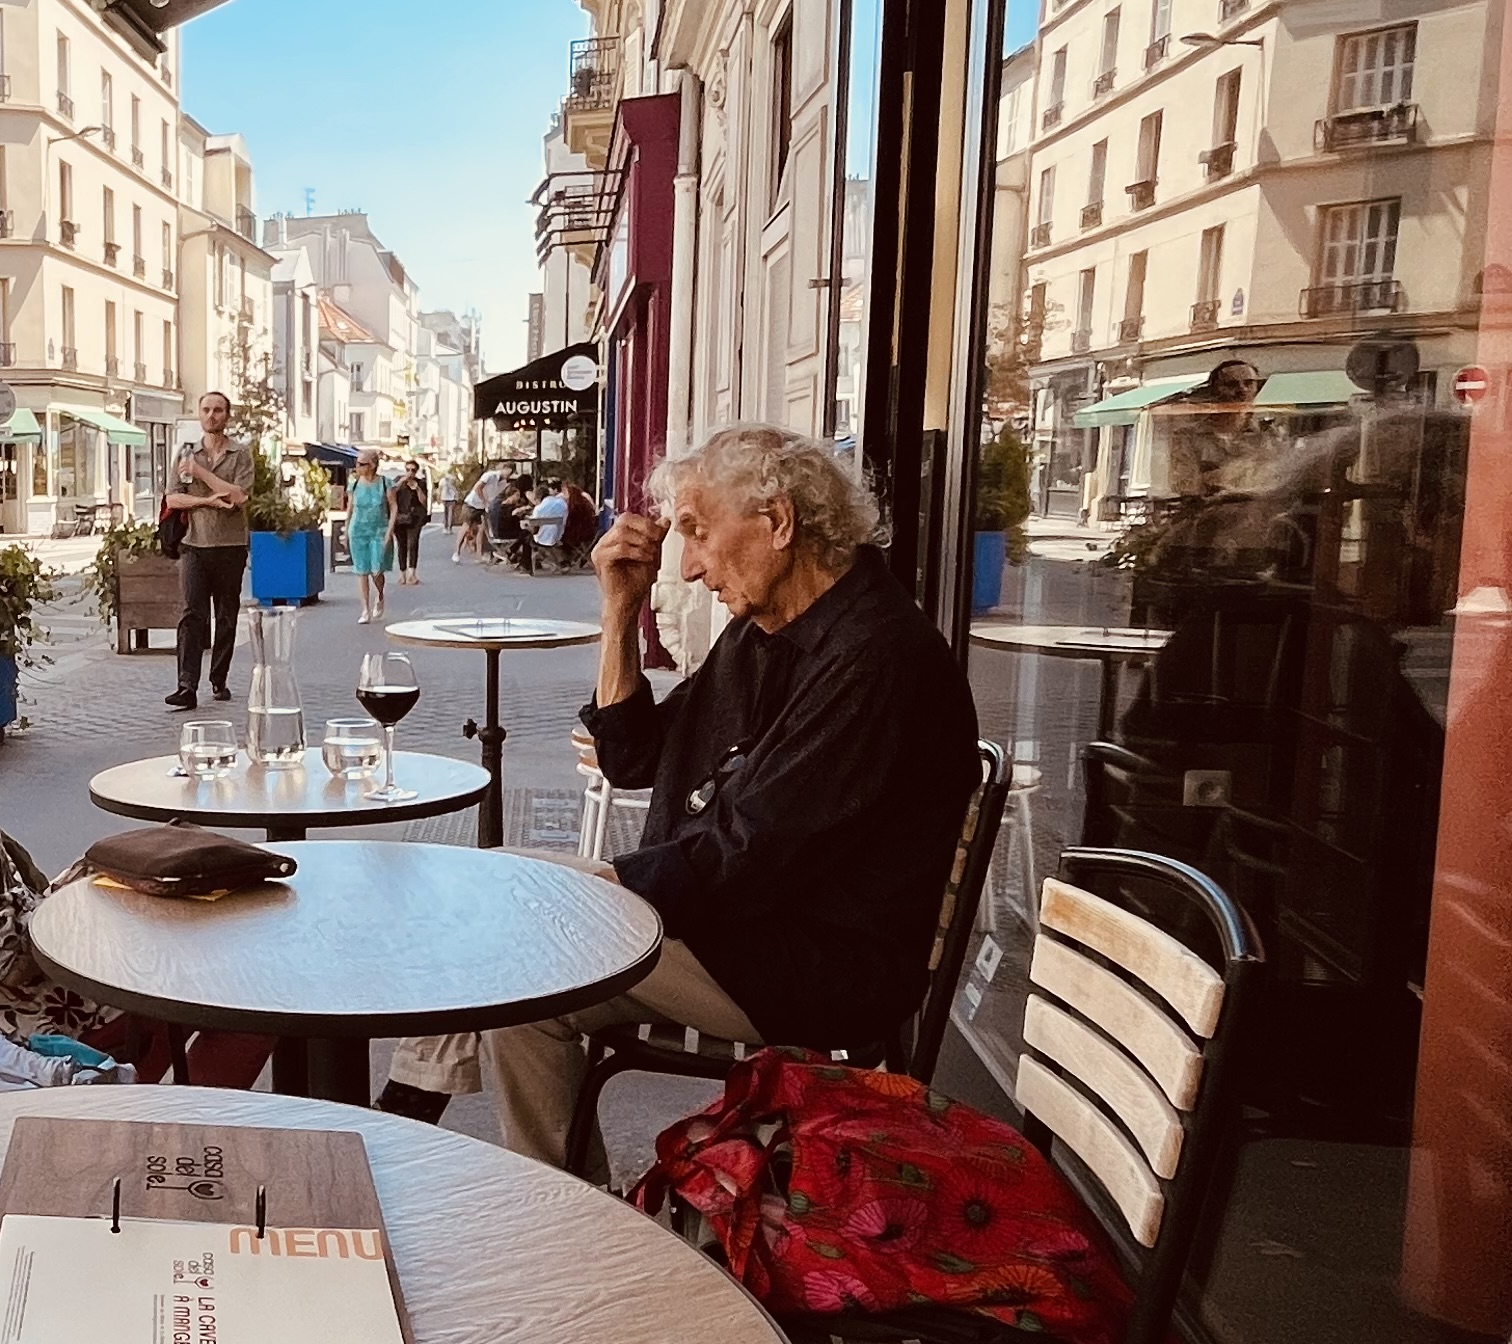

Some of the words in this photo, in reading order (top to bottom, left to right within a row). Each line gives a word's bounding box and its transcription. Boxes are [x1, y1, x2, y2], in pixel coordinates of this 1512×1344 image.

[494, 399, 578, 415] AUGUSTIN
[175, 1157, 202, 1177] del
[204, 1146, 224, 1178] casa
[198, 1297, 215, 1311] LA
